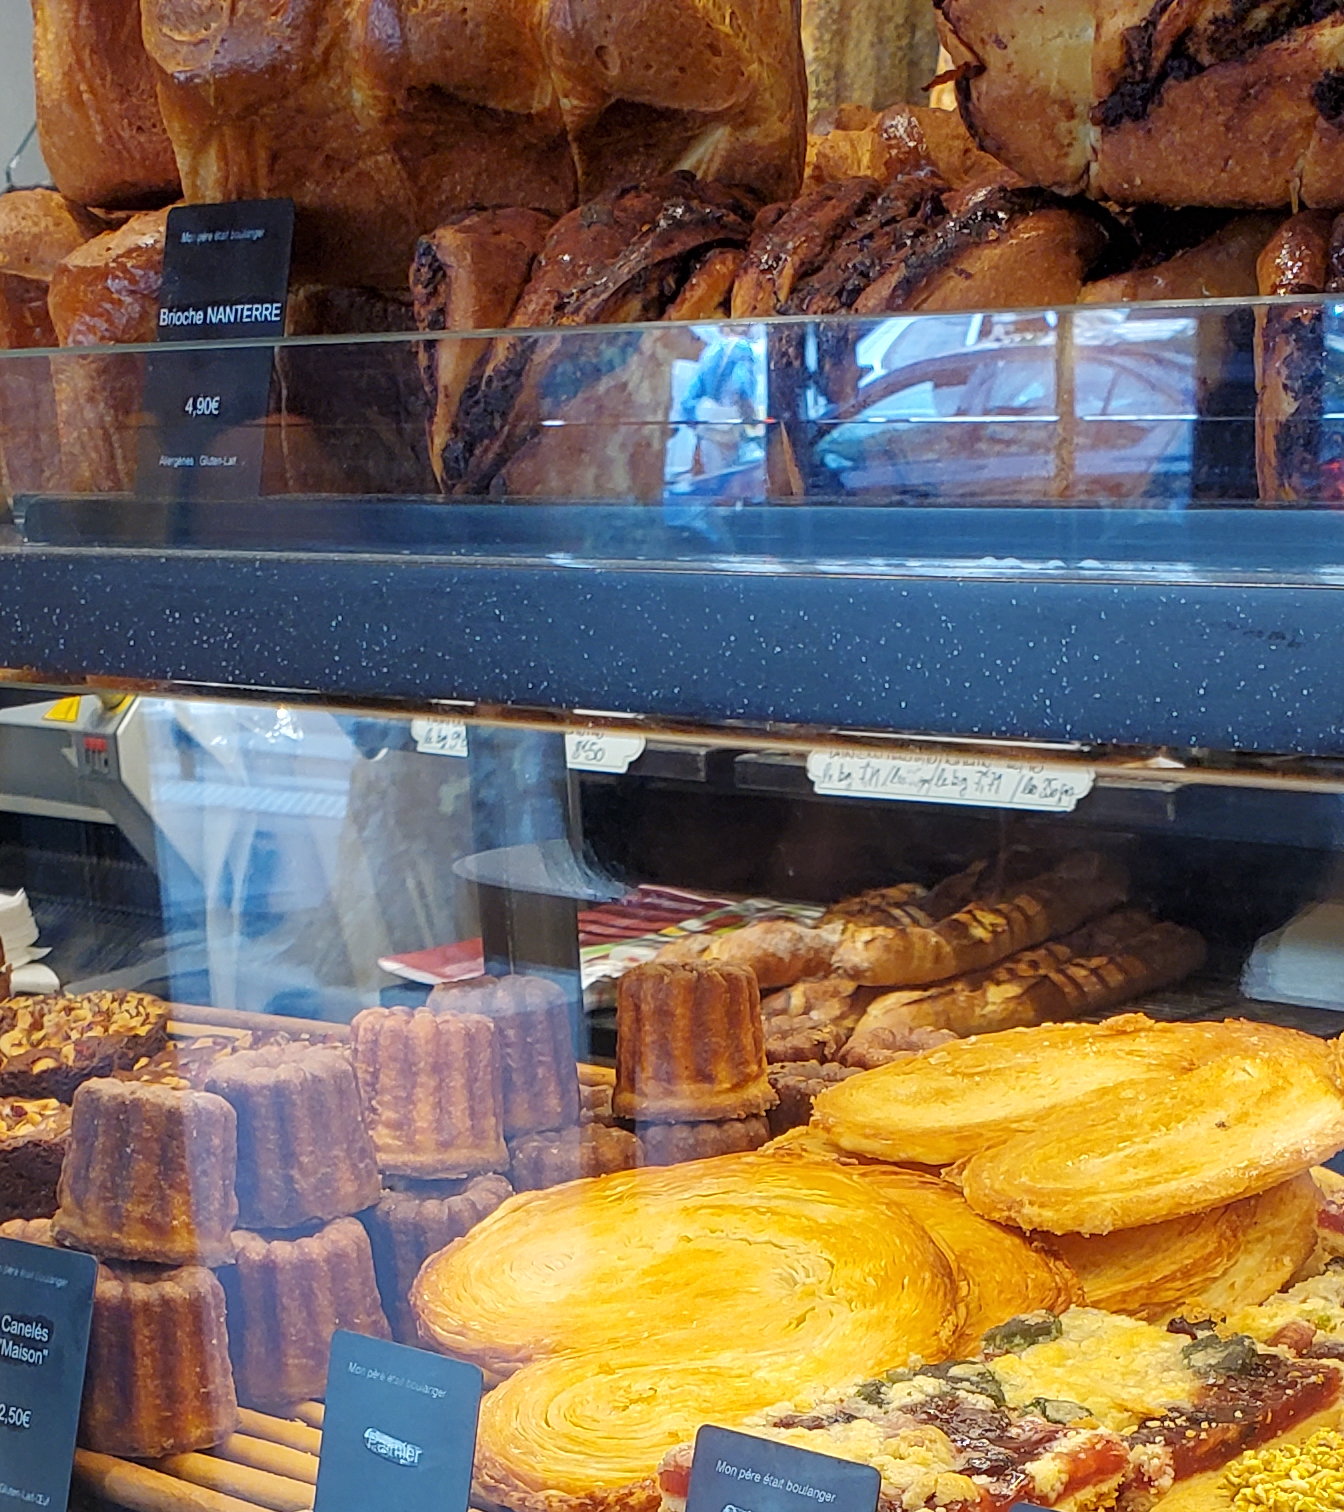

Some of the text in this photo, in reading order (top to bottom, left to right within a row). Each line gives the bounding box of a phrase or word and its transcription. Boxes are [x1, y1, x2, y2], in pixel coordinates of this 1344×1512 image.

[159, 303, 282, 326] Brioche NANTERRE
[184, 396, 220, 418] 4,90€
[1, 1314, 49, 1342] Canelés
[715, 1459, 837, 1503] Mon père était boulanger
